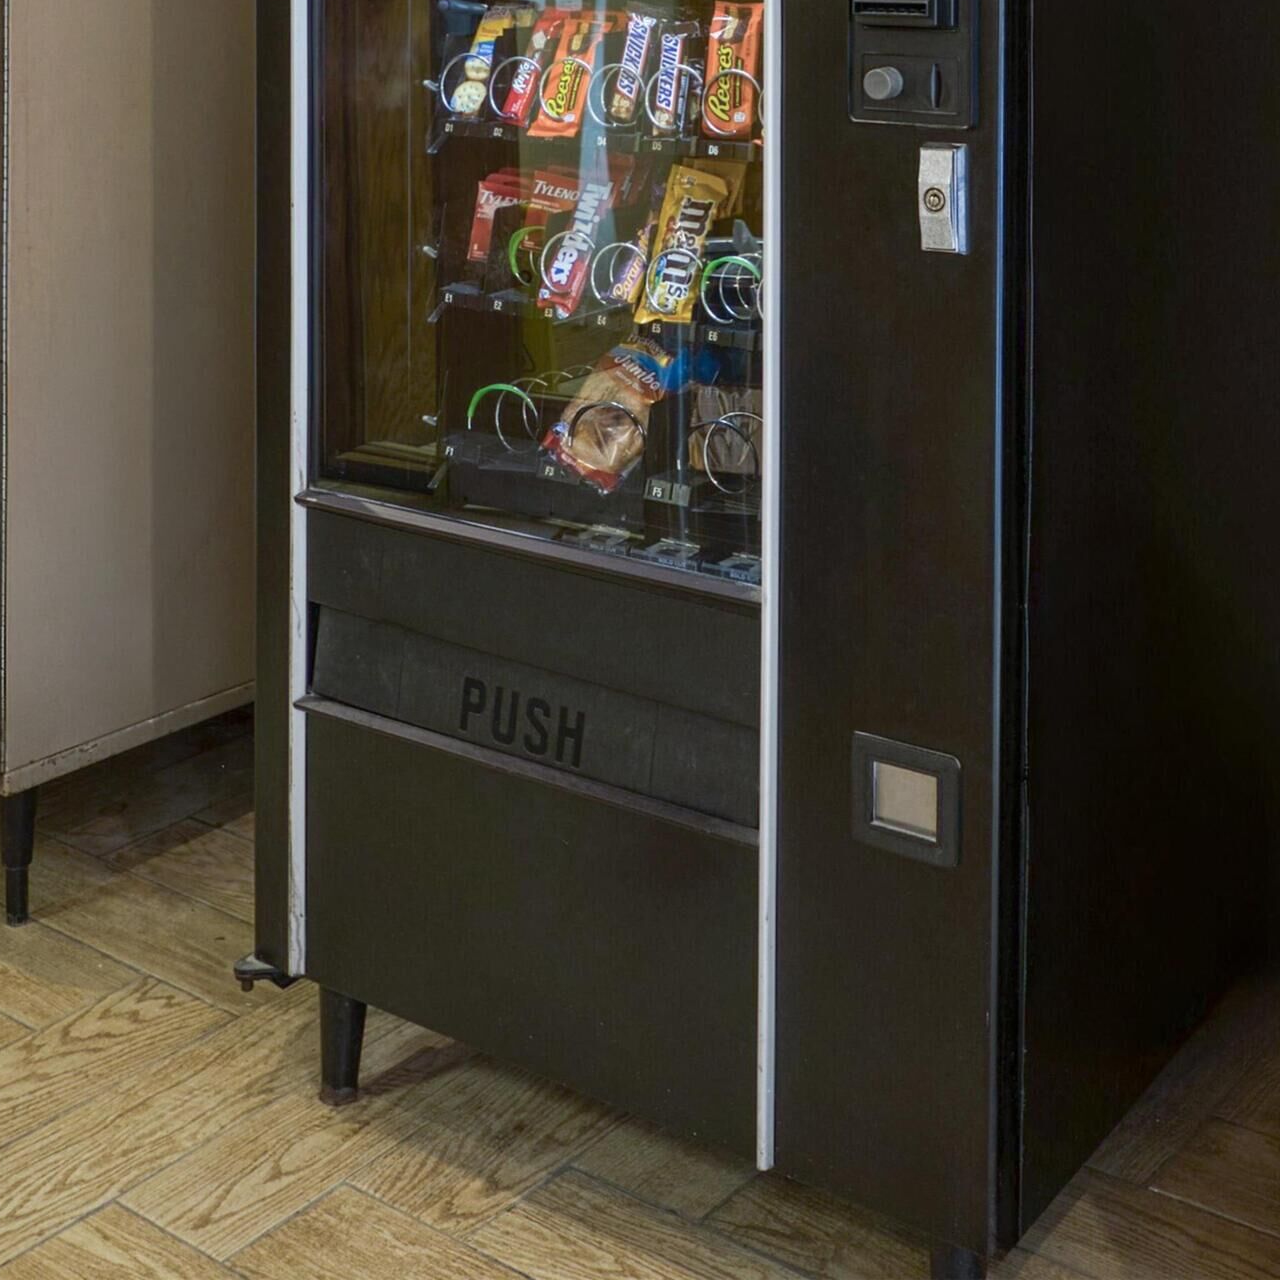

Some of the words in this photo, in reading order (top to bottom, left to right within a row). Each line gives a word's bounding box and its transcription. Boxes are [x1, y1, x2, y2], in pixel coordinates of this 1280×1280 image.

[444, 123, 454, 133] D1
[493, 127, 503, 137] D2
[597, 136, 607, 146] D4
[651, 141, 662, 151] D5
[708, 145, 719, 155] D6
[534, 179, 580, 201] TYLENO
[445, 293, 453, 303] E1
[494, 300, 502, 310] E2
[544, 308, 553, 317] E3
[597, 315, 606, 325] E4
[652, 324, 661, 333] E5
[708, 331, 718, 341] E6
[614, 353, 661, 389] Jumbo
[445, 446, 454, 456] F1
[545, 465, 554, 476] F3
[652, 486, 663, 497] F5
[458, 676, 586, 769] PUSH
